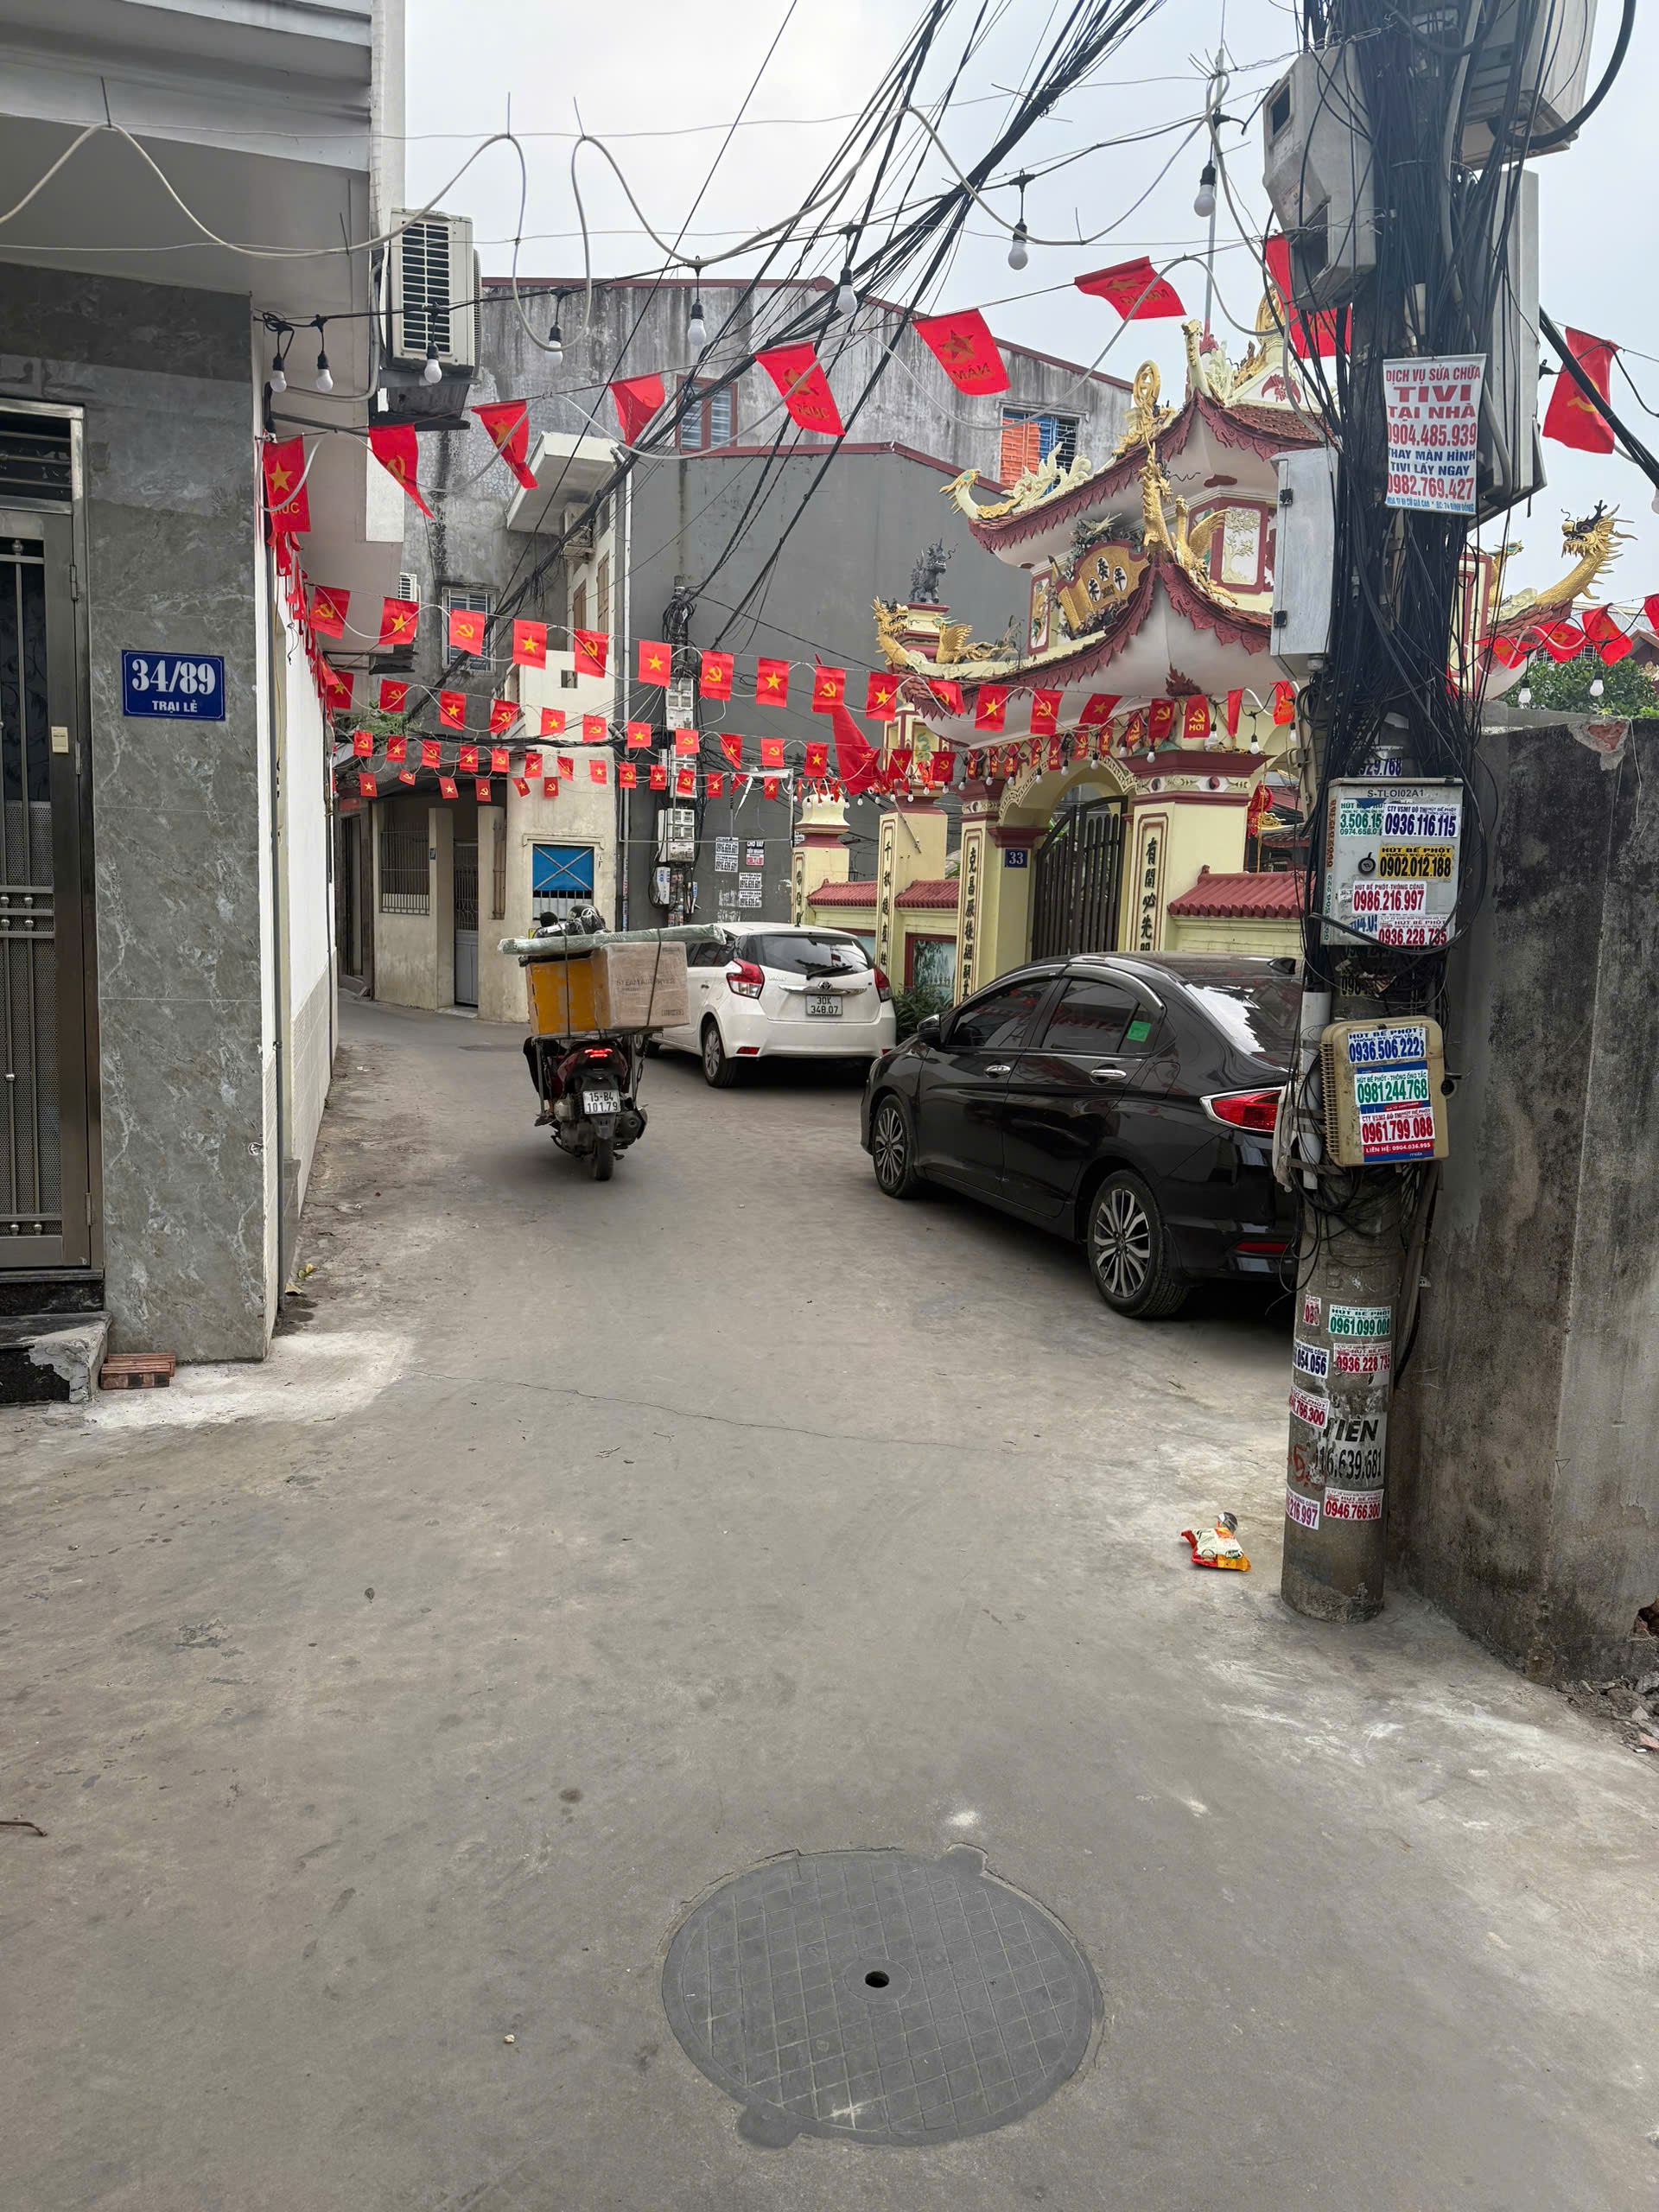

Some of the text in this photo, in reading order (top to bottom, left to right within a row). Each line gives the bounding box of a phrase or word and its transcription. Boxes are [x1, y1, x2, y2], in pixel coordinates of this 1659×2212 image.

[1386, 364, 1480, 385] DỊCH VỤ SỬA CHỮA
[1394, 385, 1471, 403] TIVI
[1388, 403, 1475, 422] TẠI NHÀ
[1387, 422, 1477, 447] 0904.485.939
[1415, 449, 1443, 461] MÀN
[1446, 449, 1476, 461] HÌNH
[1391, 461, 1470, 476] TIVI LẤY NGAY
[1388, 473, 1474, 500] 0982.769.427
[131, 658, 216, 695] 34/89
[151, 700, 180, 713] TRẠI
[1385, 812, 1457, 837] 0936.116.115
[1008, 851, 1024, 865] 33
[1380, 856, 1452, 877] 0902.012.188
[1353, 890, 1425, 912] 0986.216.997
[810, 1006, 838, 1014] 348.07
[817, 996, 832, 1005] 30K
[1349, 1036, 1421, 1063] 0936.506.222
[588, 1091, 613, 1103] 15-B4
[1357, 1077, 1427, 1104] 0981.244.768
[588, 1101, 618, 1113] 101.79
[1362, 1116, 1433, 1143] 0961.799.088
[1325, 1500, 1381, 1520] 0946.766.300
